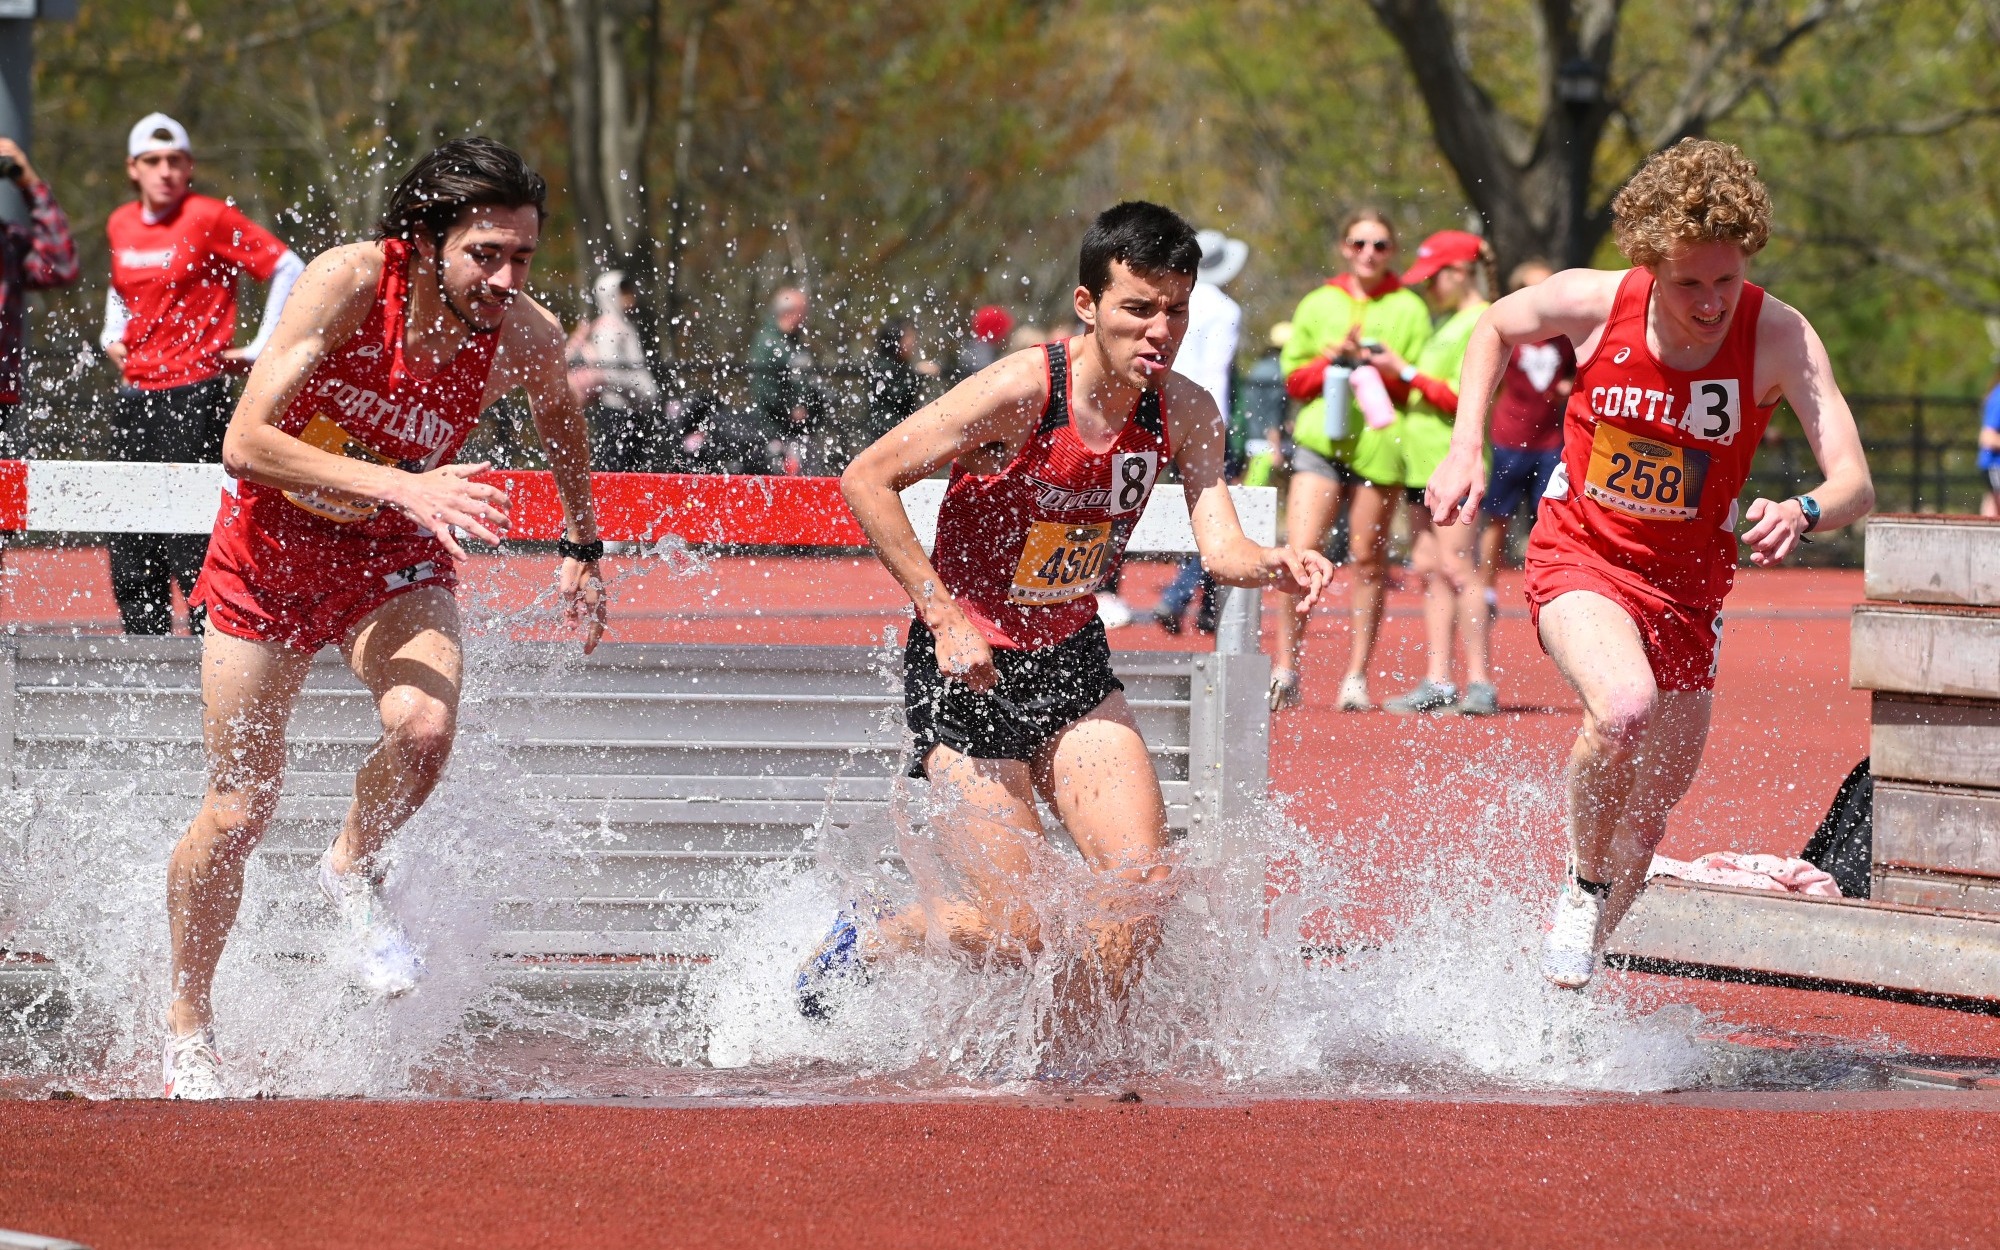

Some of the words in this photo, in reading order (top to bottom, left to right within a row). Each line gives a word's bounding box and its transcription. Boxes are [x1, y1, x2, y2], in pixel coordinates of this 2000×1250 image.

[316, 378, 454, 449] CORTLAND
[1592, 386, 1734, 446] CORTLA
[1701, 383, 1731, 438] 3
[1119, 456, 1147, 510] 8
[1606, 452, 1683, 503] 258
[1037, 542, 1105, 586] 460
